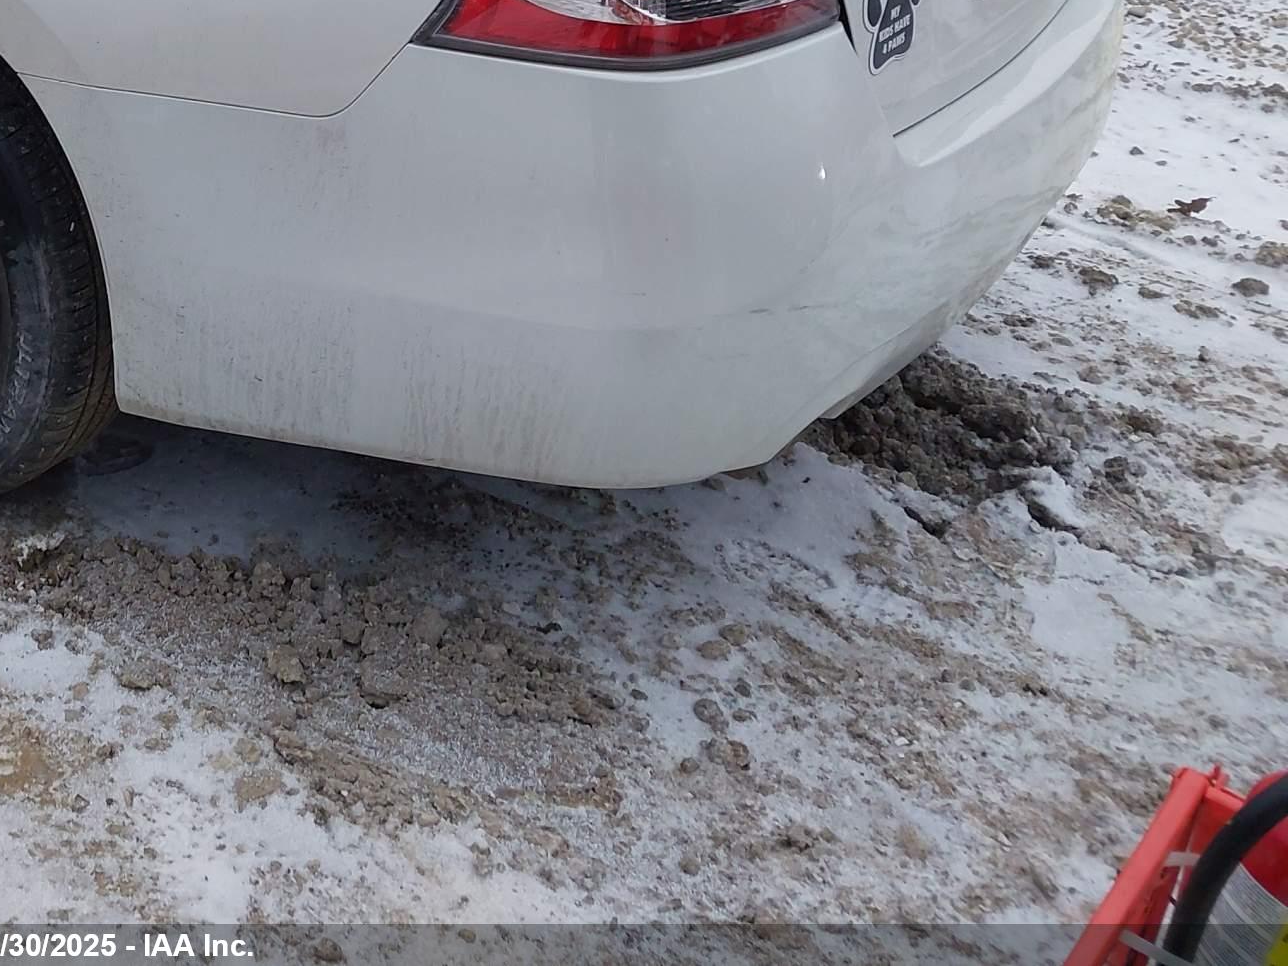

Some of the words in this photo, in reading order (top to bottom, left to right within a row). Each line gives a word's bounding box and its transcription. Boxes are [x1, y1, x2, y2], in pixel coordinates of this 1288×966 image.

[890, 4, 901, 21] MY
[878, 24, 894, 43] KIDS
[894, 13, 911, 34] HAVE
[882, 42, 888, 54] 4
[887, 32, 906, 53] PAWS
